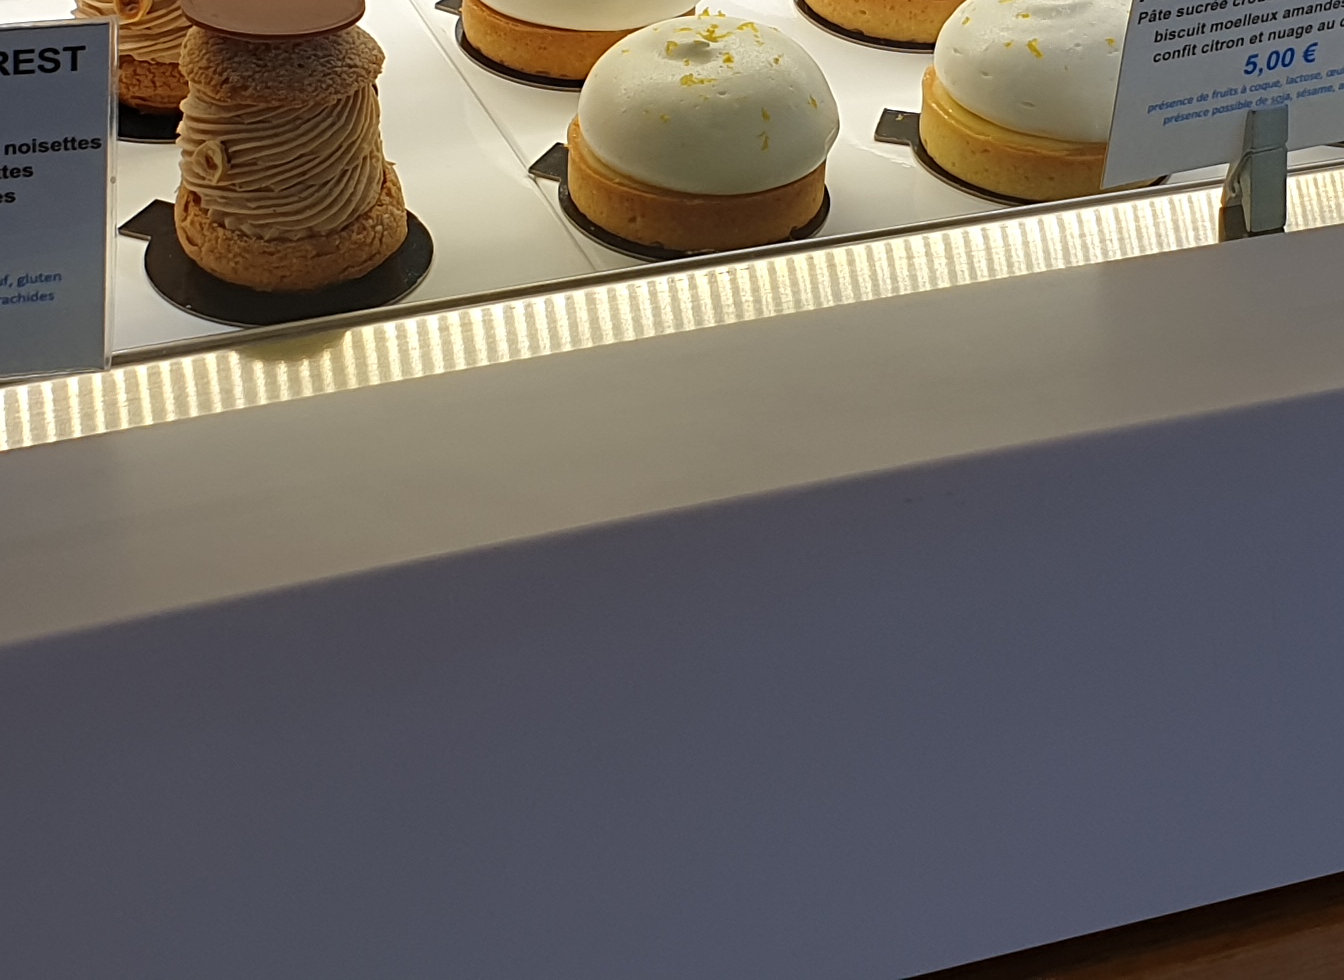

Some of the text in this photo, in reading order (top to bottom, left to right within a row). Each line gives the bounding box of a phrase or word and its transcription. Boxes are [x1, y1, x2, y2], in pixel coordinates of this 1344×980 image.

[1138, 8, 1172, 25] Pâte
[1154, 23, 1206, 43] biscuit
[1210, 10, 1278, 32] moelleux
[1153, 44, 1197, 63] confit
[1201, 36, 1244, 55] citron
[1249, 32, 1263, 46] et
[1268, 22, 1313, 42] nuage
[1317, 18, 1335, 31] au
[1244, 42, 1319, 77] 5,00 €
[1147, 97, 1193, 114] présence
[1196, 93, 1209, 102] de
[1212, 87, 1238, 100] fruits
[1241, 84, 1247, 94] à
[1163, 108, 1209, 126] présence
[1212, 100, 1253, 116] possible
[1255, 96, 1268, 106] de
[4, 135, 102, 155] noisettes
[16, 270, 62, 287] gluten
